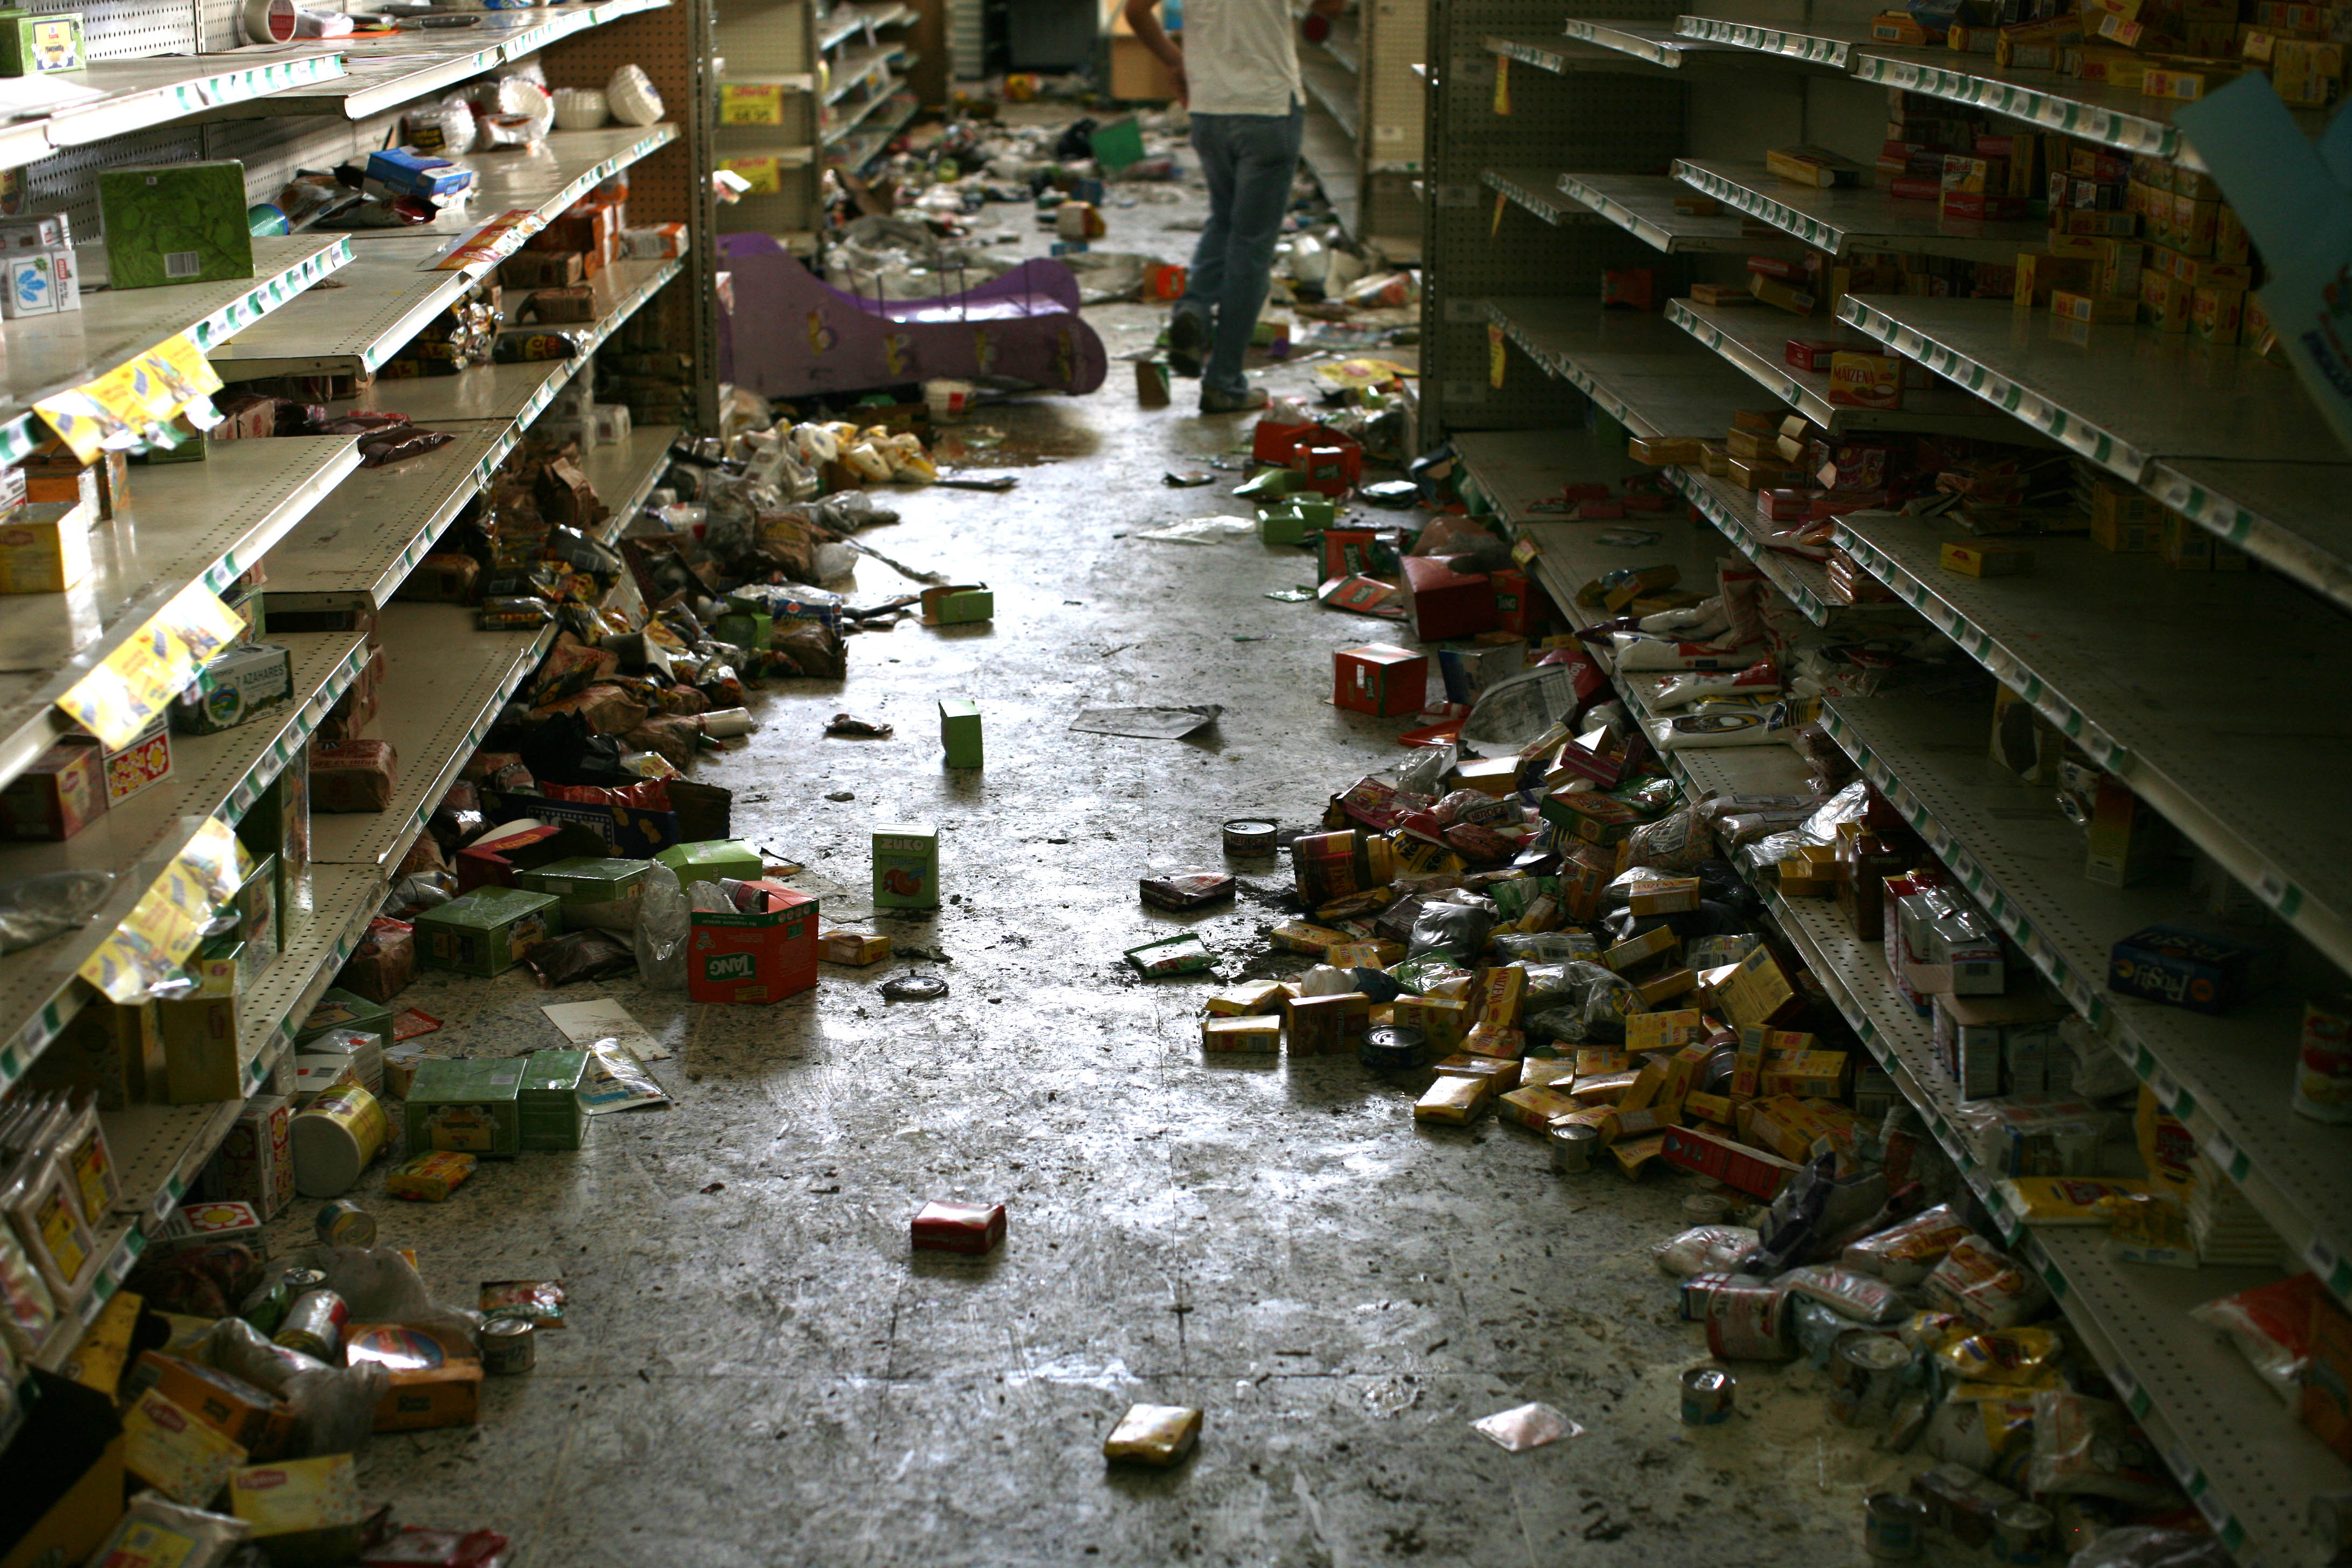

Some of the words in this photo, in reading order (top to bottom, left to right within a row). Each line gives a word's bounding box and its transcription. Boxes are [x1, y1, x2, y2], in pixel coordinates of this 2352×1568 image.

[1833, 366, 1875, 384] MAIZENA
[1472, 805, 1505, 821] HERDEZ
[880, 837, 925, 851] ZUKO
[1230, 835, 1264, 845] HERDEZ
[1628, 880, 1675, 891] MAIZENA
[709, 954, 753, 977] TANG
[1489, 969, 1510, 1005] MAIZENA
[2134, 963, 2191, 1003] Frosty
